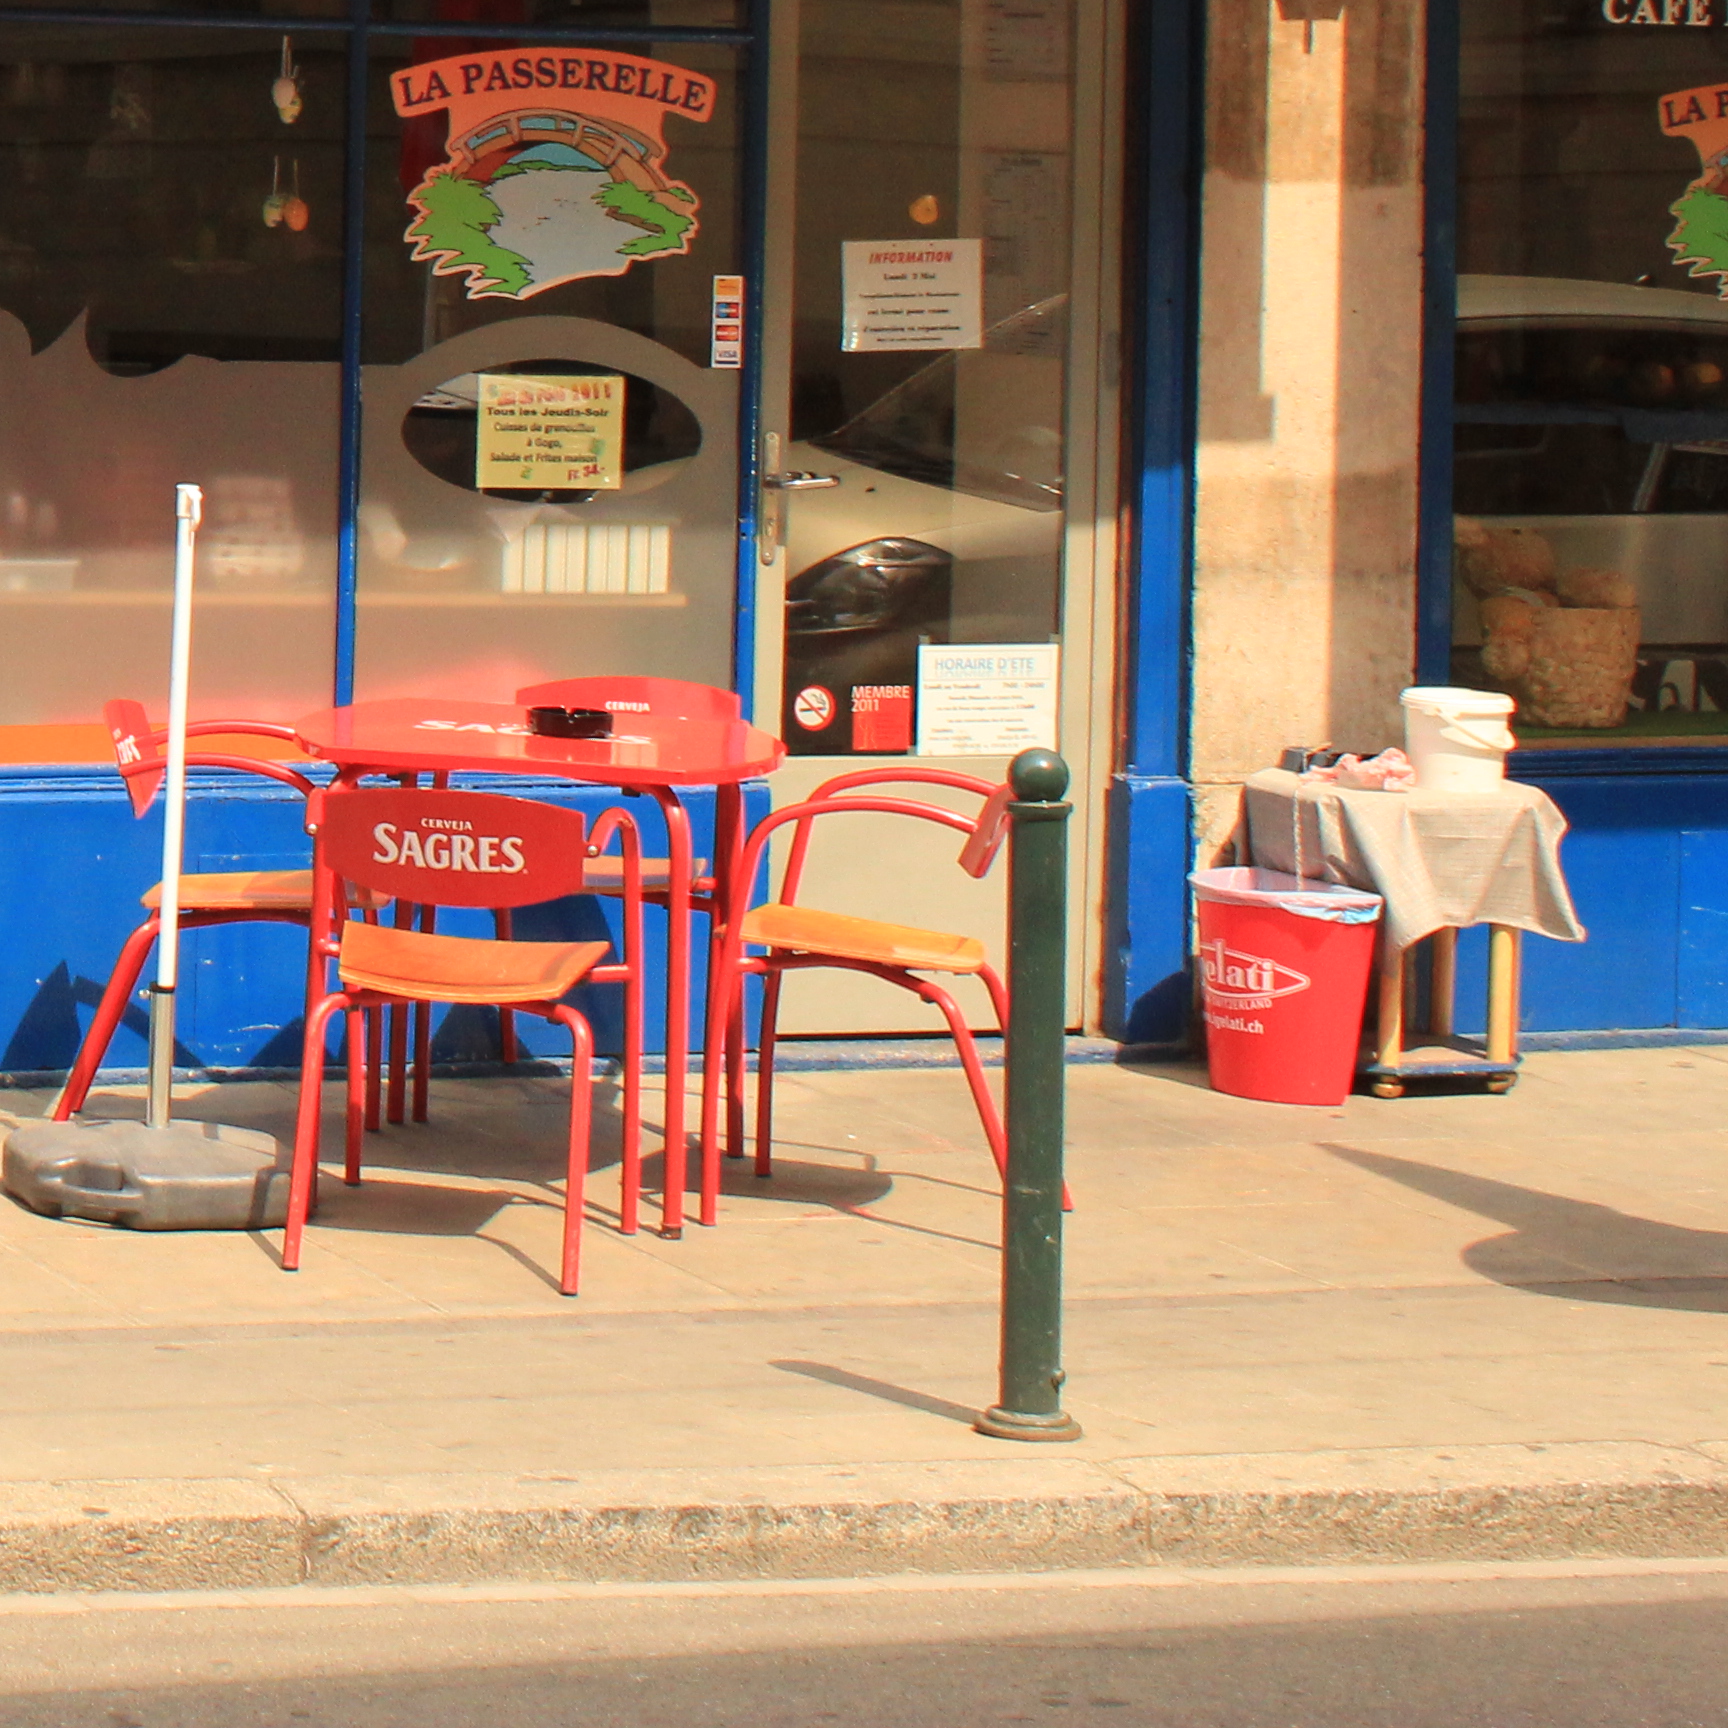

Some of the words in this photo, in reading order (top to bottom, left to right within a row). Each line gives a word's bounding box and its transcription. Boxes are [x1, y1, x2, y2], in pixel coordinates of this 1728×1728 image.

[399, 70, 451, 107] LA
[460, 58, 707, 112] PASSERELLE
[1664, 95, 1707, 128] LA
[869, 251, 953, 264] INFORMATION
[487, 407, 515, 416] Tous
[935, 657, 993, 670] HORAIRE
[851, 685, 910, 699] MEMBRE
[605, 701, 651, 712] CERVEJA
[851, 699, 880, 712] 2011
[421, 817, 473, 831] CERVEJA
[372, 822, 526, 874] SAGRES
